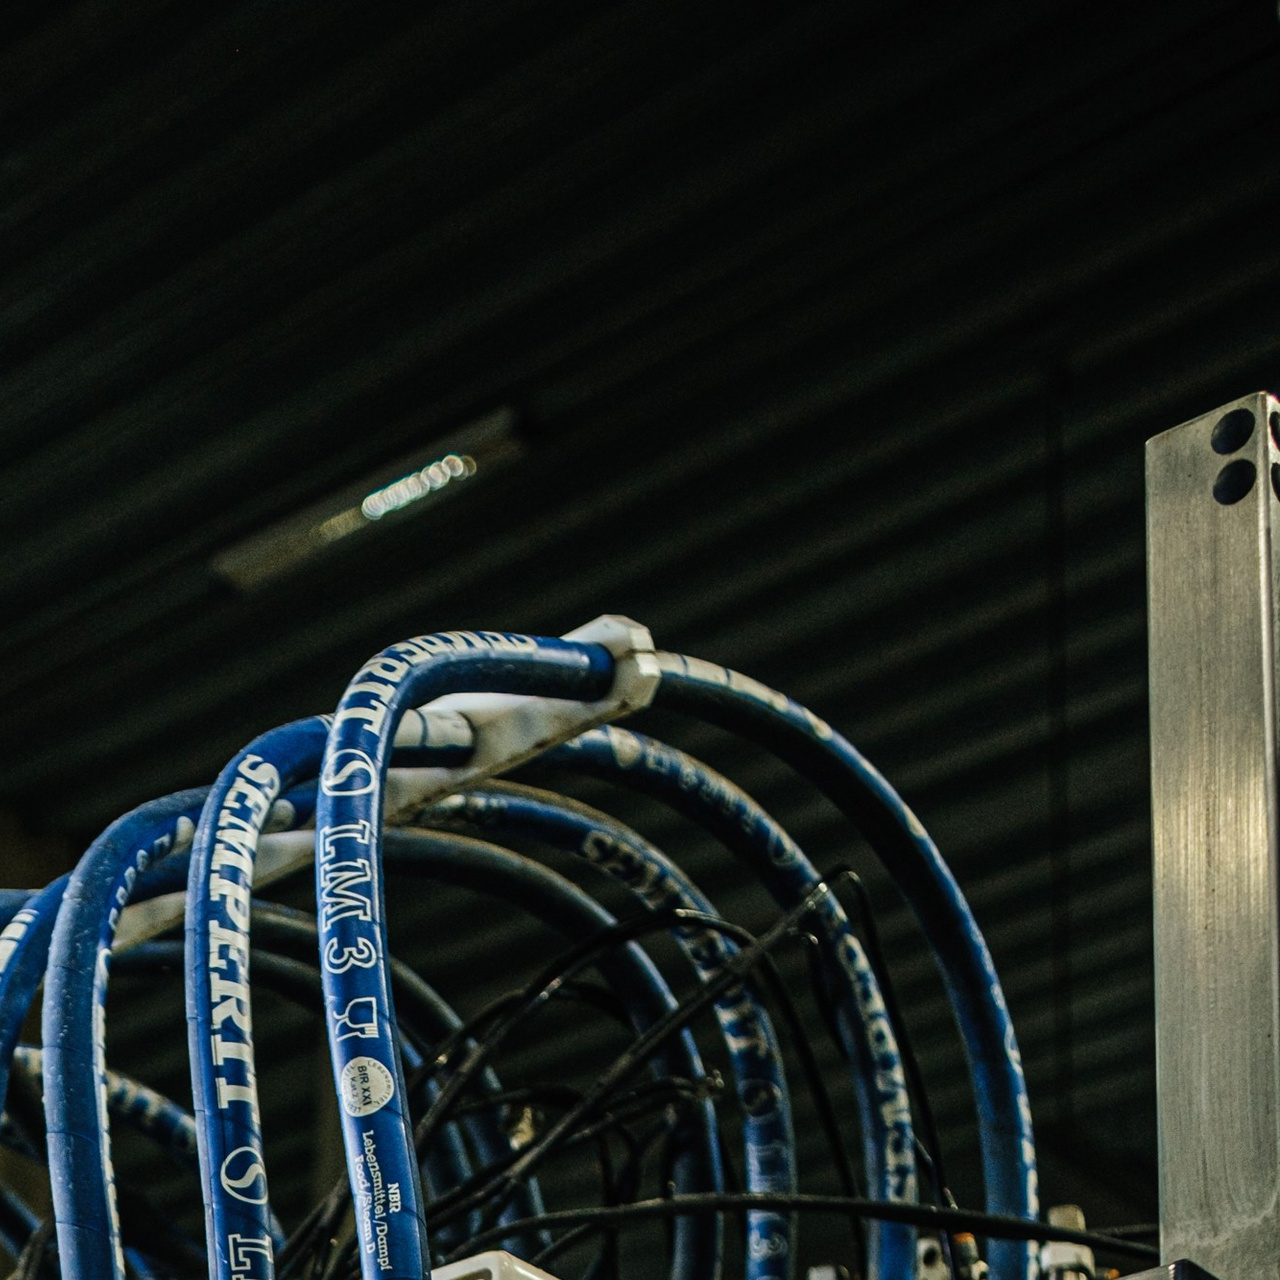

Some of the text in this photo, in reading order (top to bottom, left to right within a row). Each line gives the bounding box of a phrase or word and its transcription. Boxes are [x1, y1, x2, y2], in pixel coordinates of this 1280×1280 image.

[319, 820, 371, 933] LM
[208, 753, 282, 1129] SEMPERIT
[324, 936, 377, 975] 3
[357, 1065, 372, 1106] BfR XXI
[354, 1154, 376, 1254] Food/Steam D
[362, 1130, 394, 1271] Lebensmittel/Dampf
[387, 1182, 402, 1213] NBR
